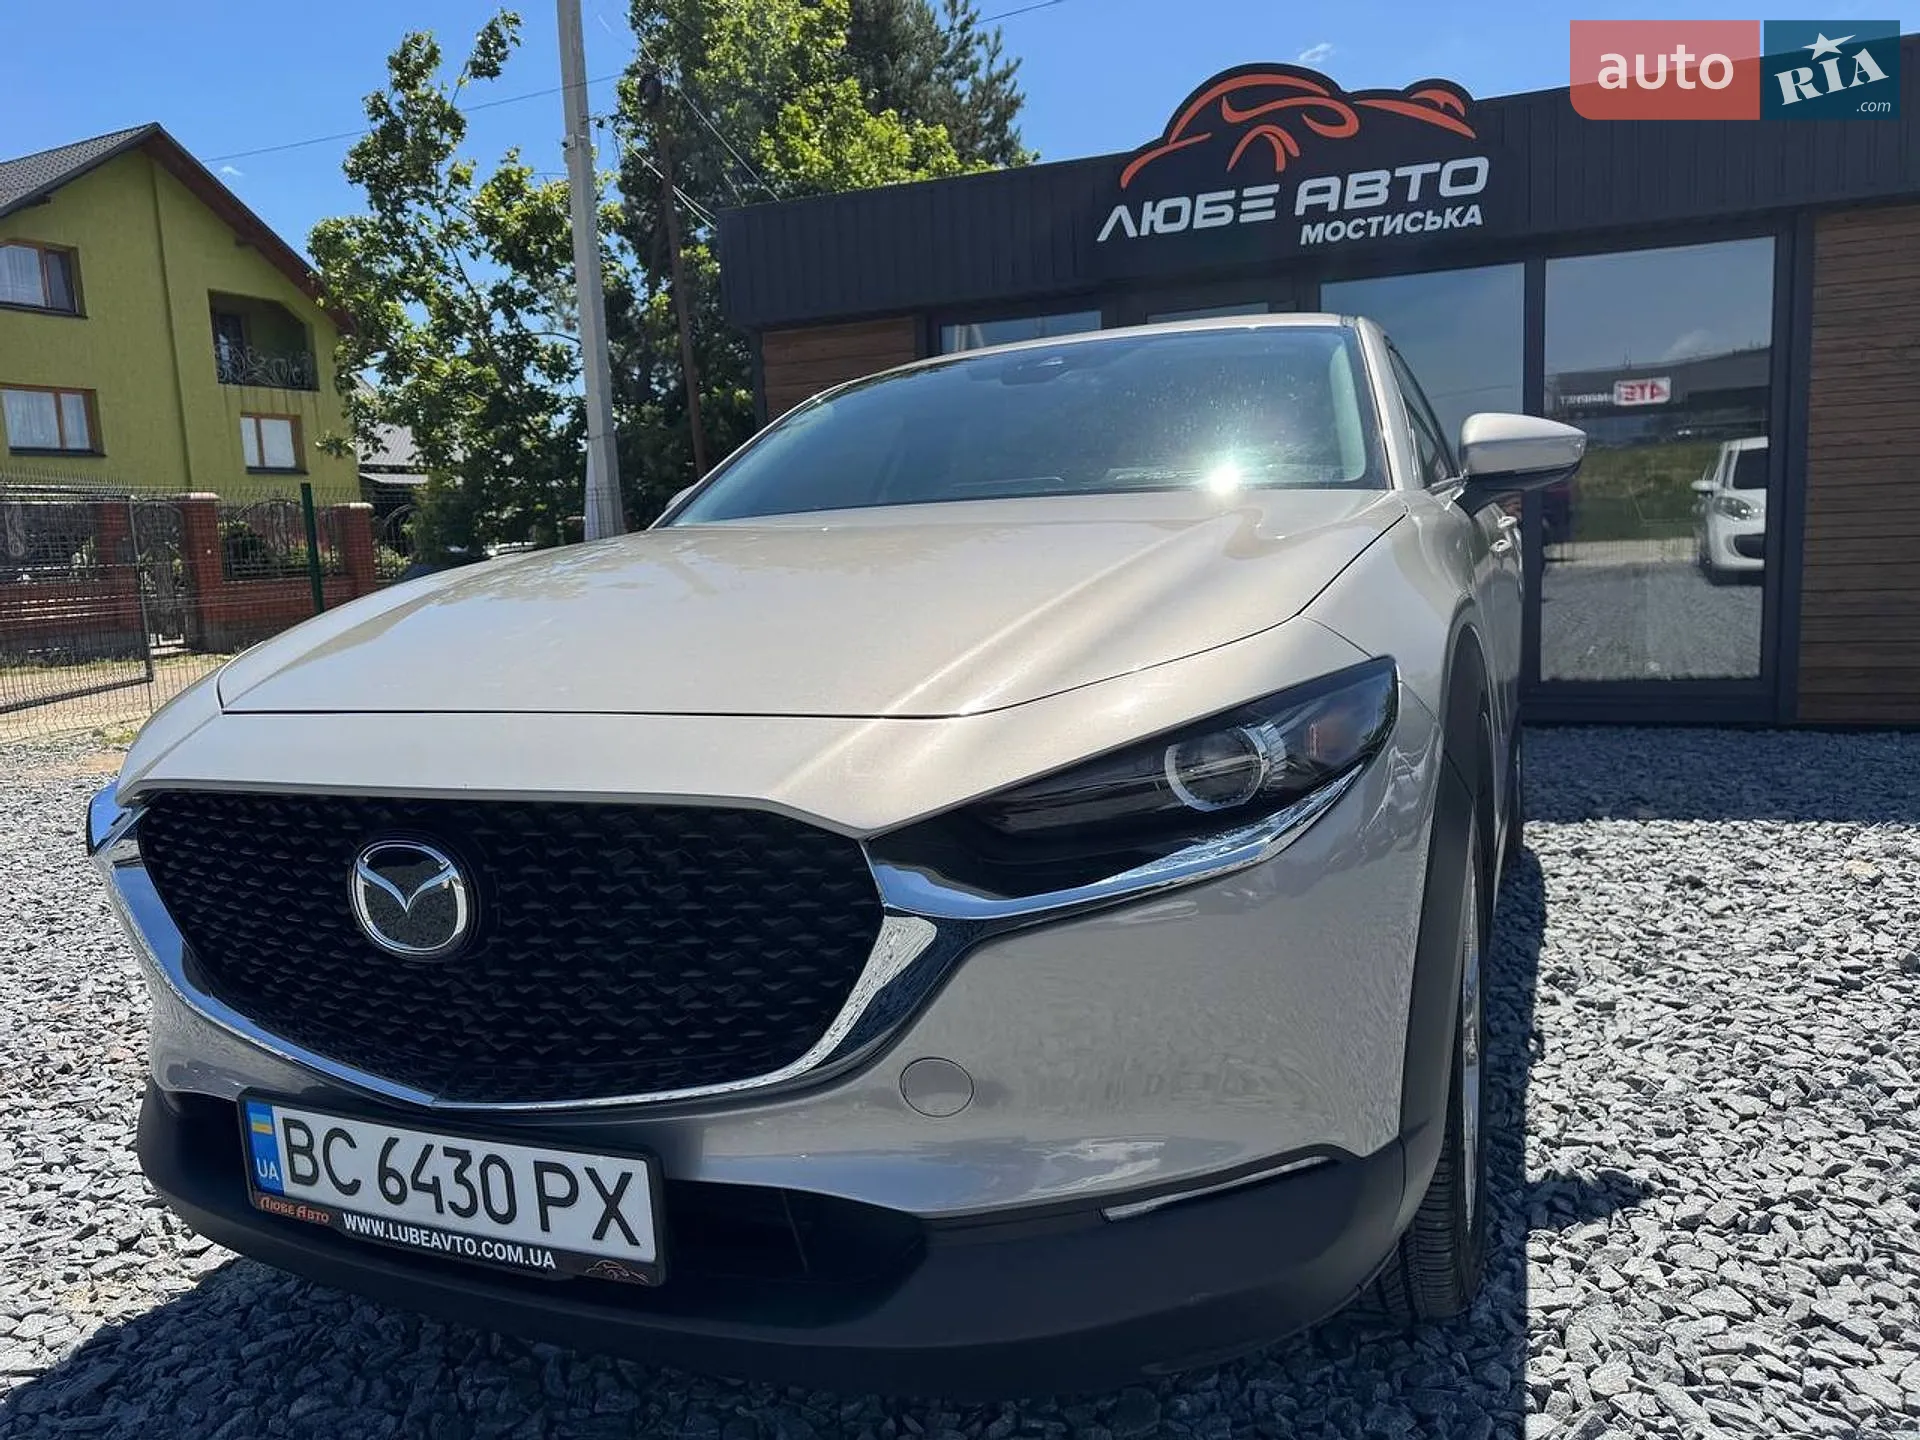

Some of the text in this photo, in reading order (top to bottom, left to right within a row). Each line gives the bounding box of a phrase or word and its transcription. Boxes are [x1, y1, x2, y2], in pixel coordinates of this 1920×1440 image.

[1097, 156, 1489, 241] ЛЮБЕ АВТО
[1300, 205, 1483, 245] МОСТИСЬКА
[256, 1157, 280, 1182] UA
[282, 1117, 641, 1247] BC 6430 PX
[342, 1213, 557, 1269] WWW.LUBEAVTO.COM.UA
